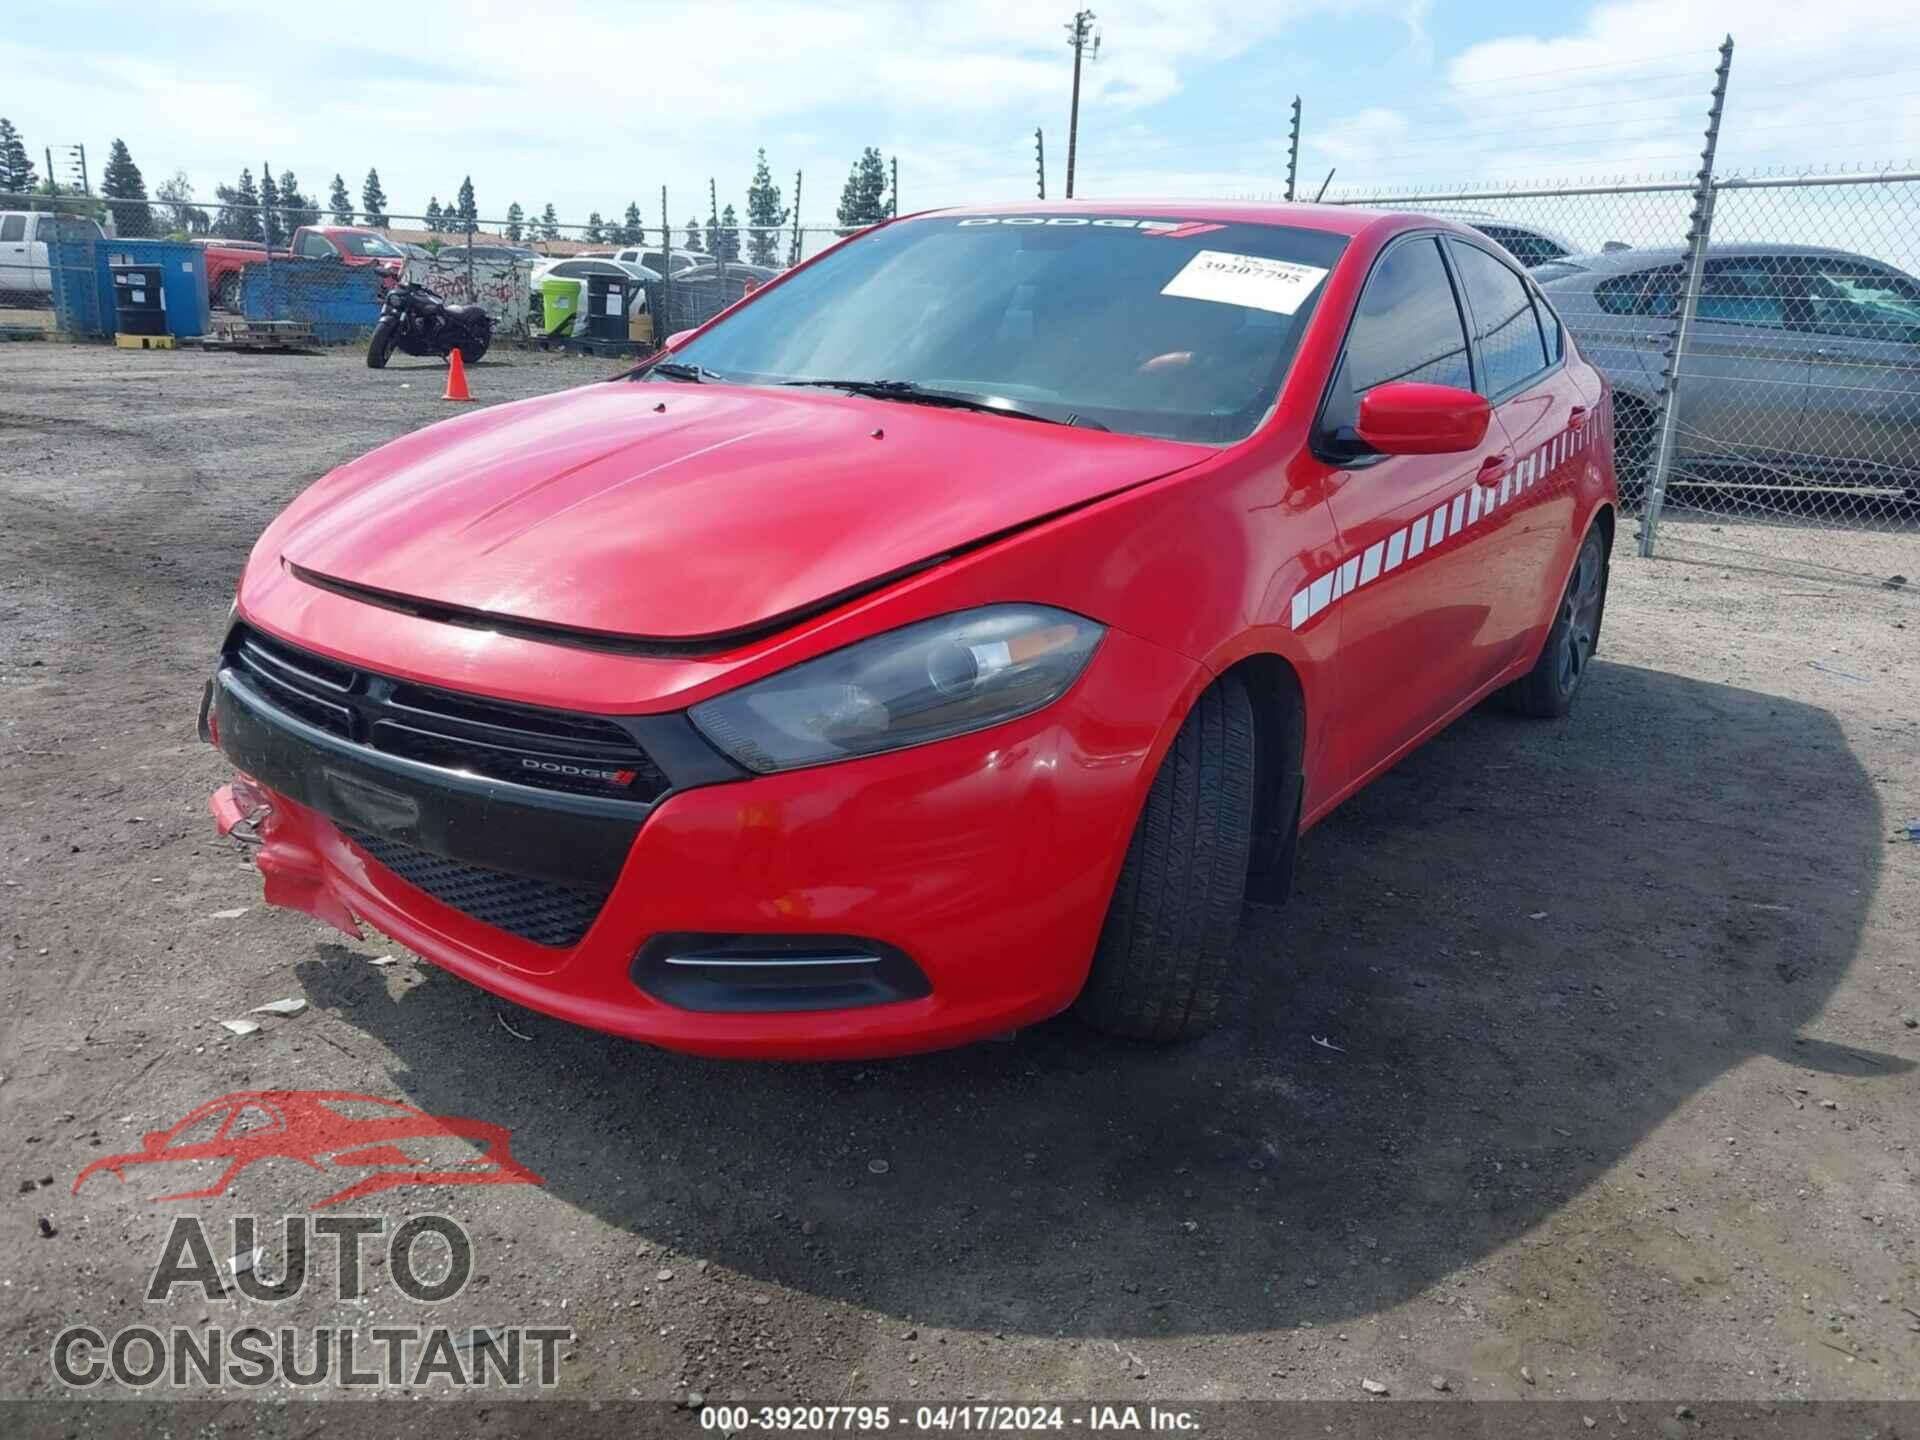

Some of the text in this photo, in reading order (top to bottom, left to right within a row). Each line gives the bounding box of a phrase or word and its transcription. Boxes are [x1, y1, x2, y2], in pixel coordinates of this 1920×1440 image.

[958, 217, 1178, 231] DODGE
[1198, 260, 1304, 284] 39207795
[522, 759, 618, 781] DODGE
